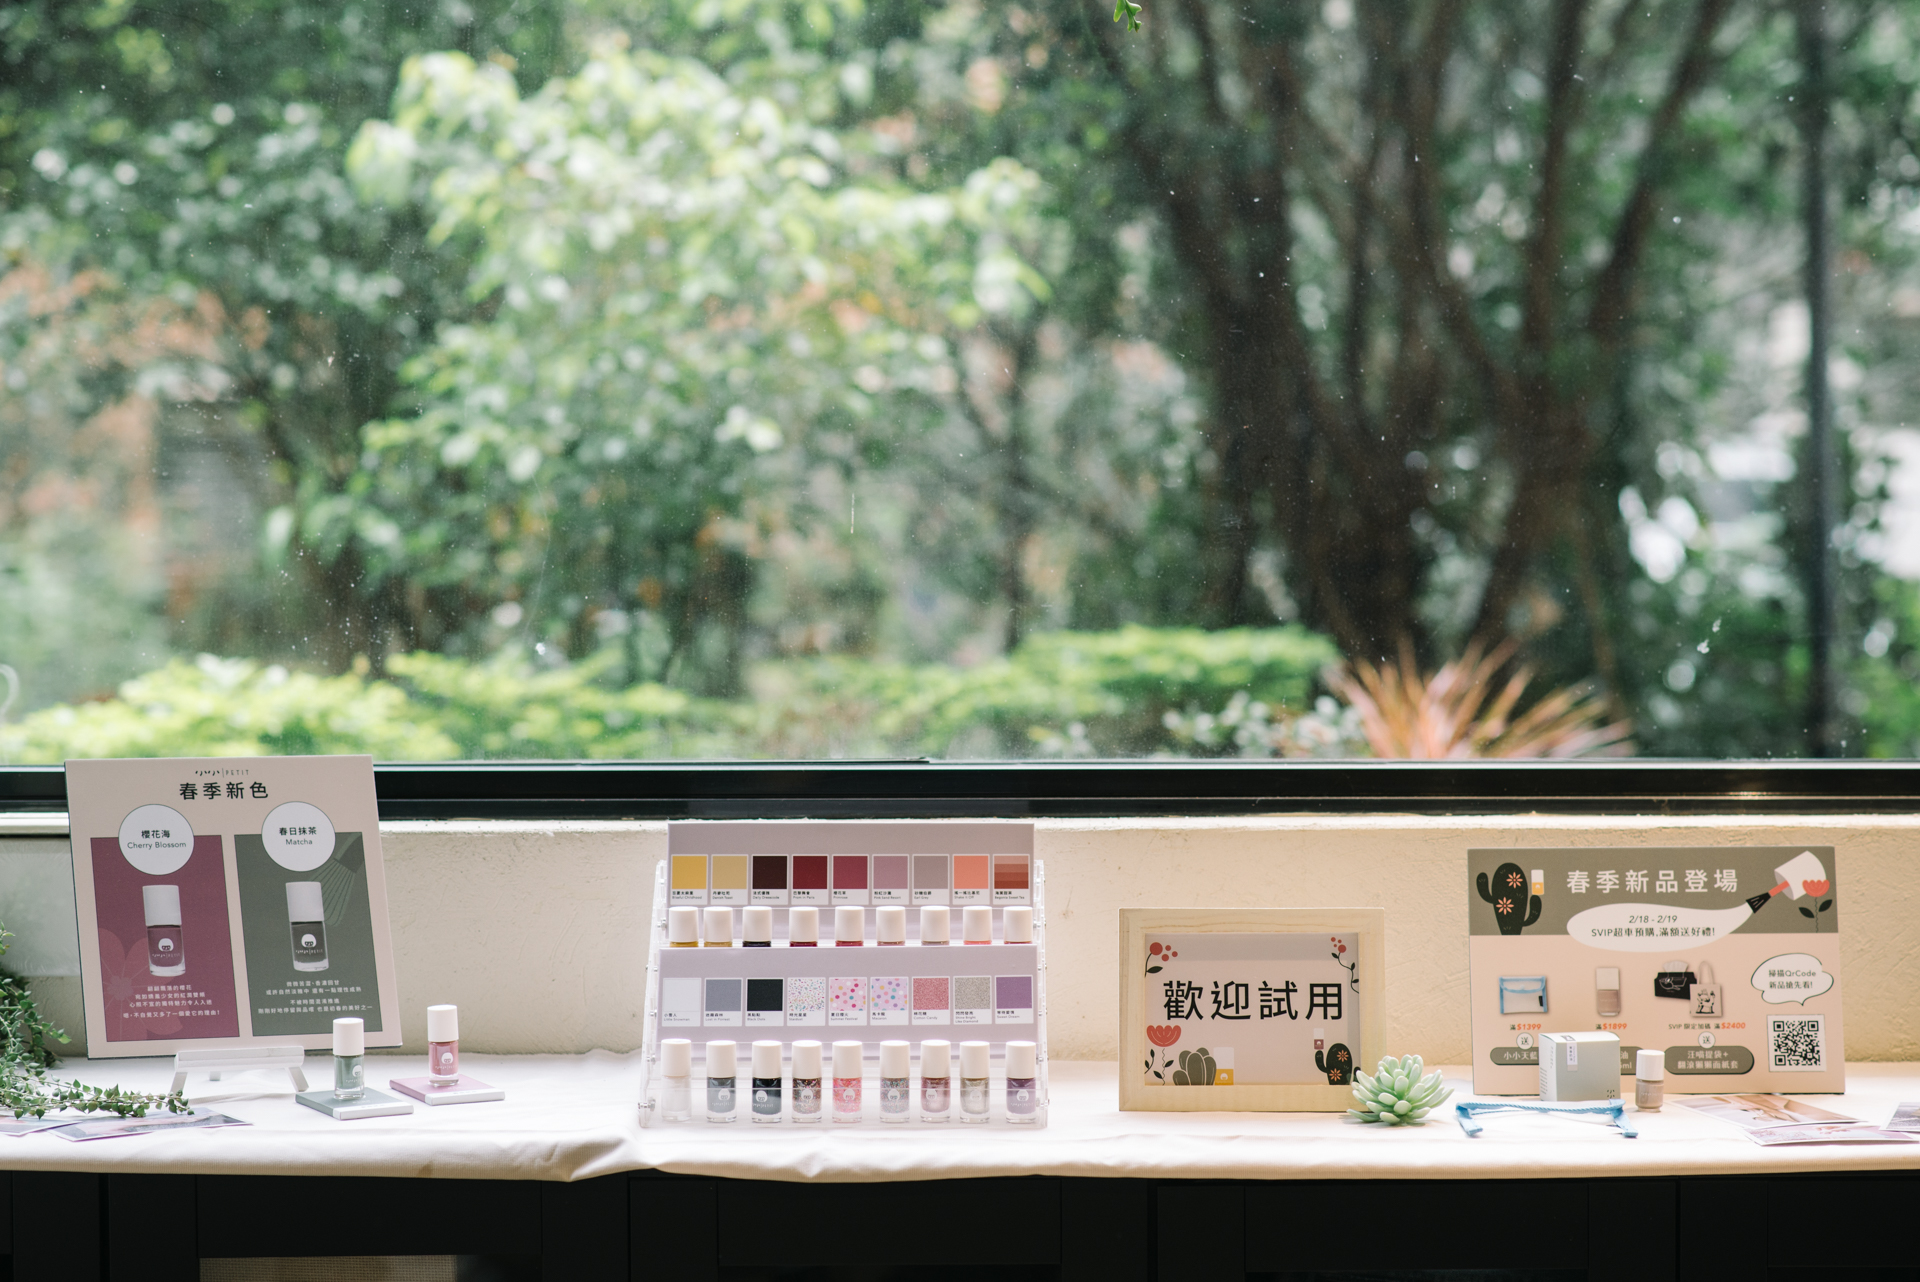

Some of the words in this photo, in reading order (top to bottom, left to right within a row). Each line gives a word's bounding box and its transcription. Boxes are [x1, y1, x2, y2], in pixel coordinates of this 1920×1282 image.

[179, 781, 269, 800] 春季新色
[141, 830, 170, 839] 櫻花海
[278, 826, 317, 836] 春日抹茶
[127, 841, 153, 850] Cherry
[155, 841, 186, 849] Blossom
[285, 838, 313, 846] Matcha
[1566, 869, 1738, 894] 春季新品登場
[1628, 915, 1649, 924] 2/18
[1657, 915, 1678, 924] 2/19
[1163, 980, 1342, 1021] 歡迎試用
[1520, 1037, 1529, 1045] 送
[1702, 1035, 1711, 1045] 送
[1503, 1051, 1538, 1060] 小小天藍
